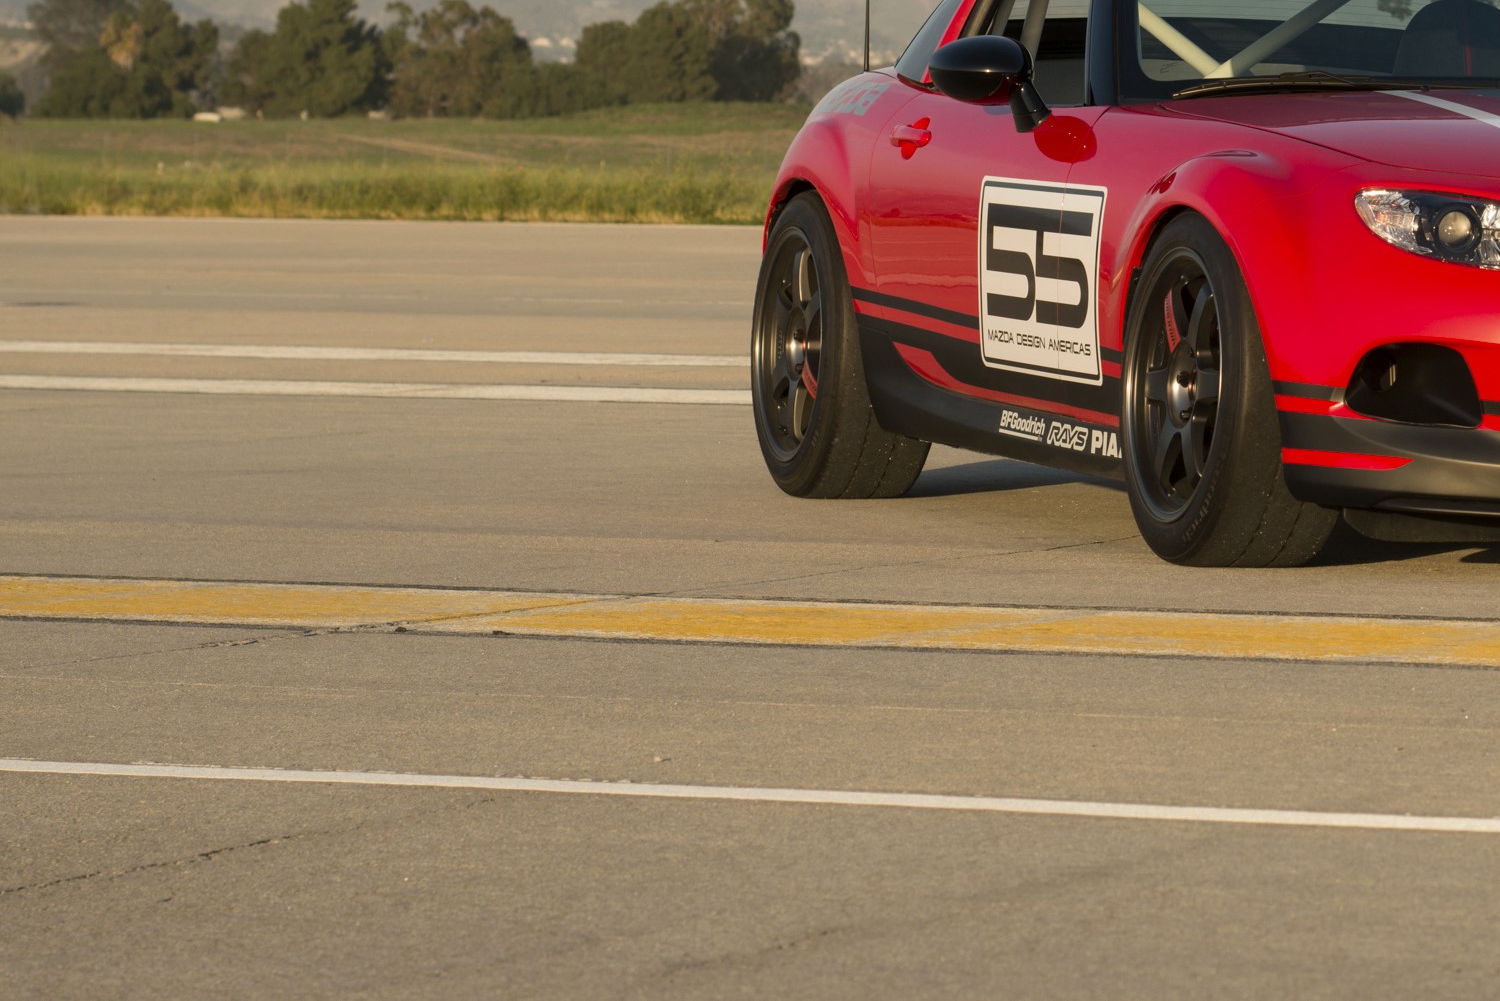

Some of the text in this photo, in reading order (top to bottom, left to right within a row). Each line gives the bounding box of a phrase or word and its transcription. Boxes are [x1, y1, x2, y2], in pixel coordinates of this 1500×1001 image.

[986, 202, 1094, 329] 55
[987, 328, 1092, 356] MAZDA DESIGN AMERICAS
[1000, 409, 1122, 459] BFGoodrich RAYS PIA
